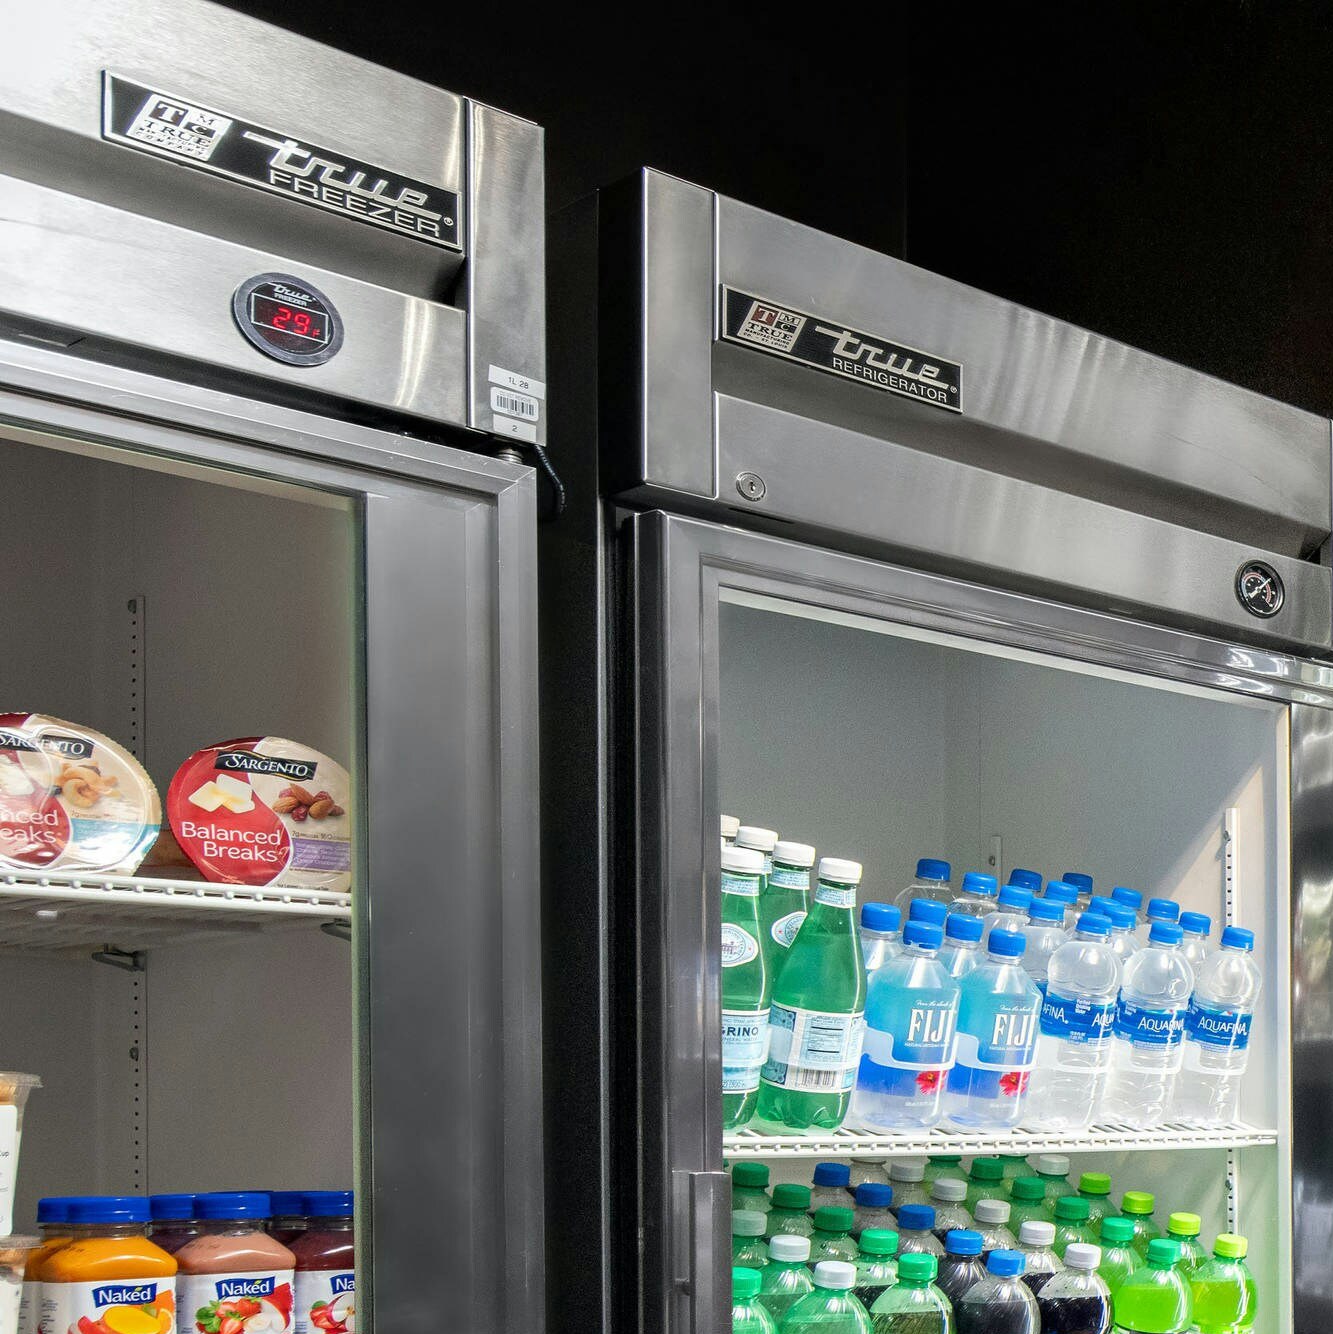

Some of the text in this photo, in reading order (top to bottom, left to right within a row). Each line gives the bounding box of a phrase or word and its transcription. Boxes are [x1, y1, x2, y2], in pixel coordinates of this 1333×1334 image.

[269, 169, 440, 238] FREEZER
[271, 307, 312, 335] 29
[747, 320, 793, 341] TRUE
[832, 357, 948, 404] REFRIGERATOR
[225, 753, 310, 777] SARGENTO
[181, 821, 282, 847] Balanced
[203, 841, 278, 863] Breaks
[907, 1007, 957, 1045] FIJI
[992, 1013, 1039, 1047] FIJI
